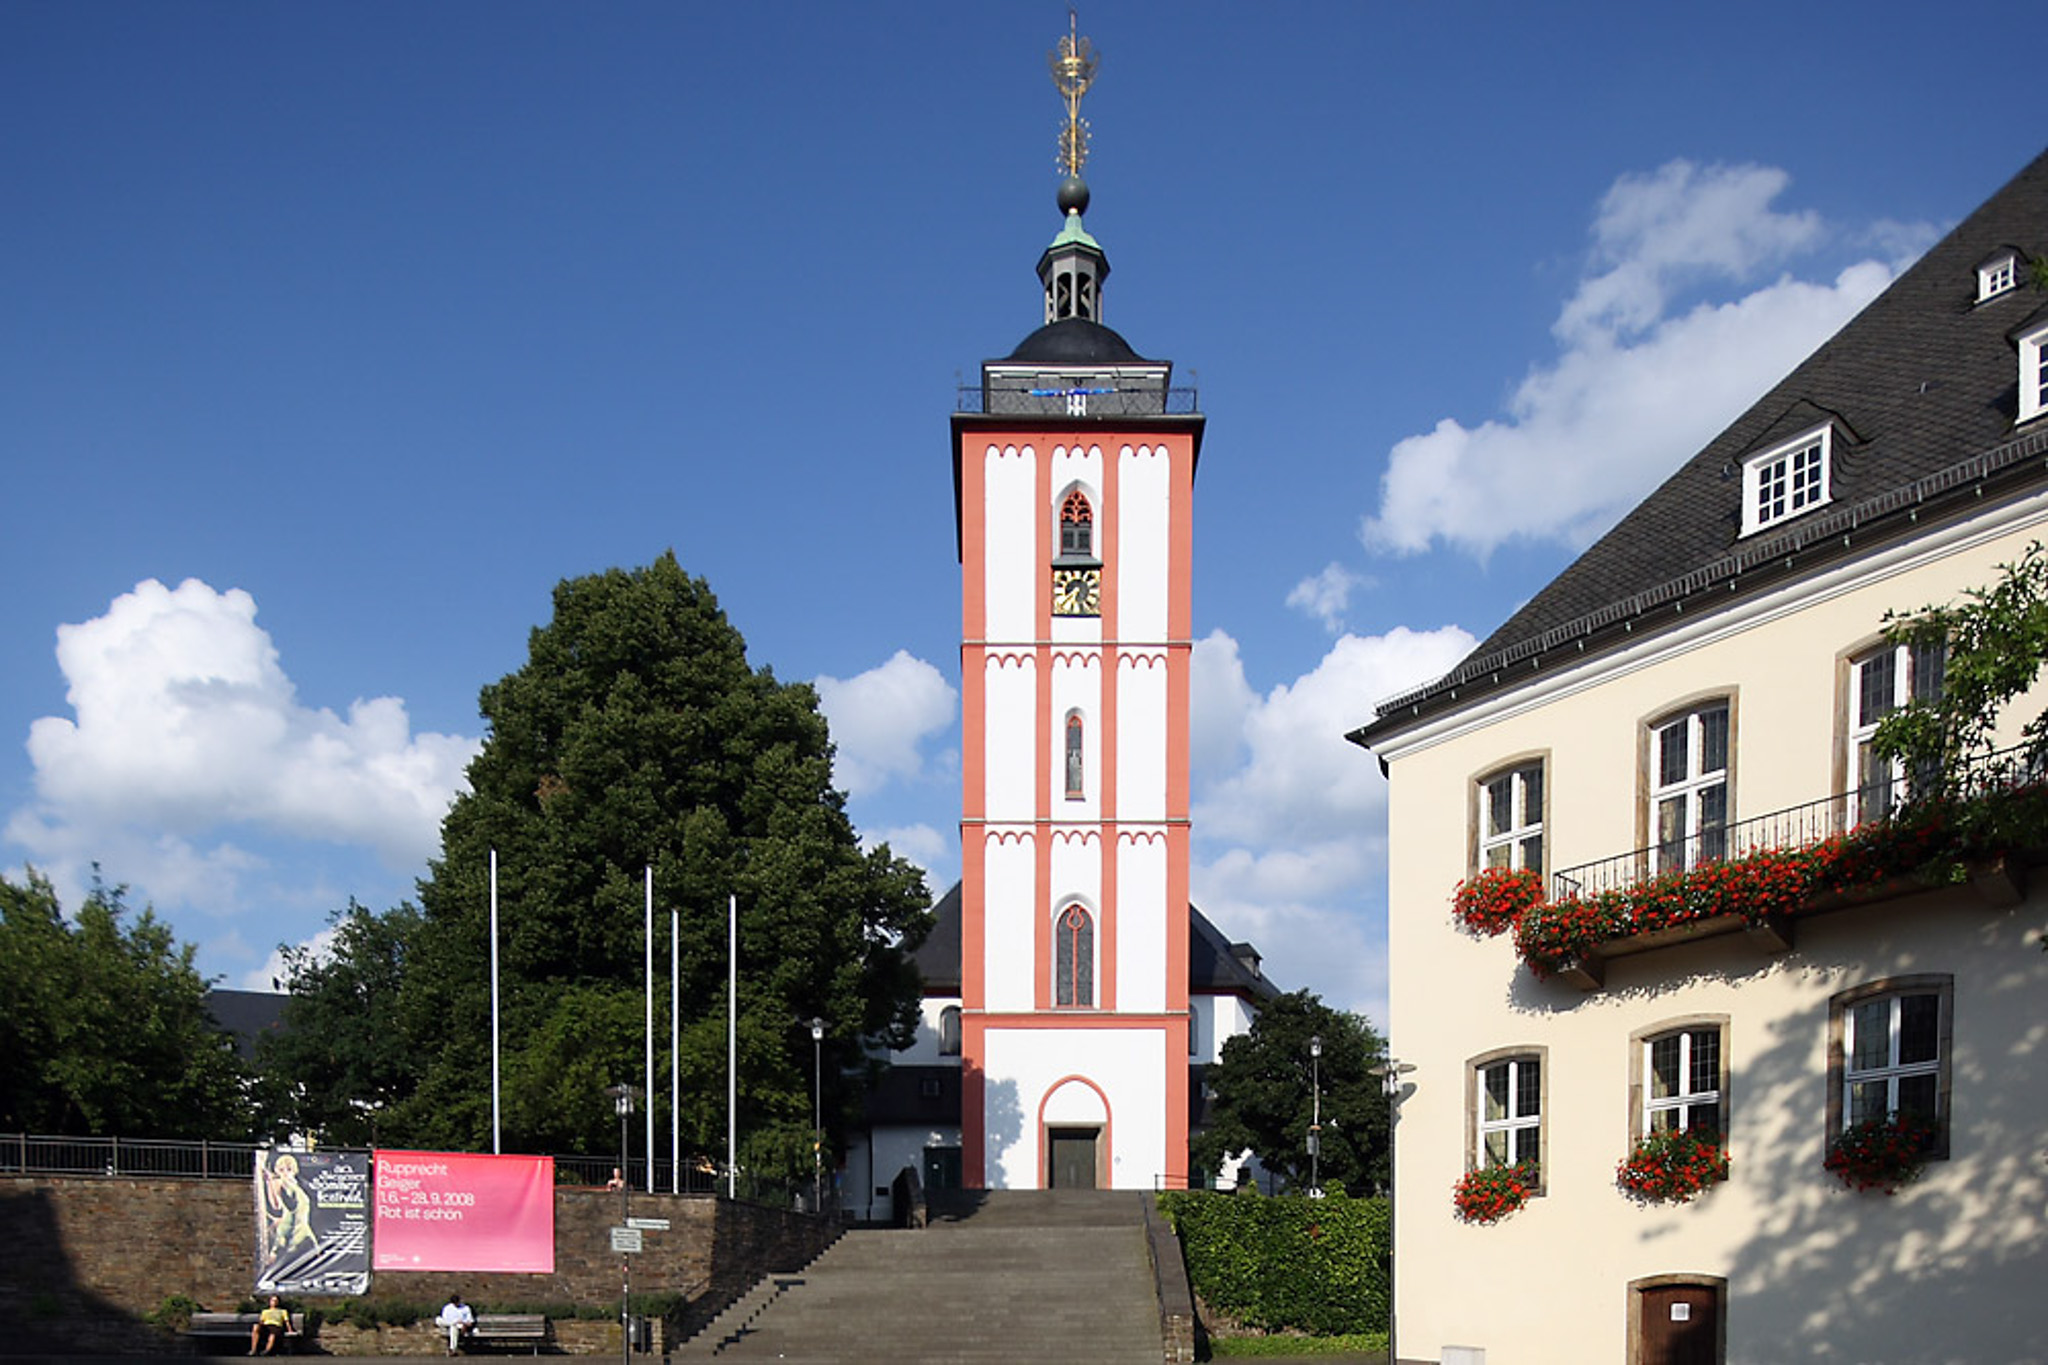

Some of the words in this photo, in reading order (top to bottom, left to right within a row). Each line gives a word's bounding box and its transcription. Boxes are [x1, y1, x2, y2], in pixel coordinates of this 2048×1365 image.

[379, 1160, 448, 1179] Rupprecht
[378, 1175, 421, 1193] Geiger
[379, 1205, 402, 1219] Rot
[405, 1206, 421, 1219] ist
[423, 1208, 463, 1221] schön
